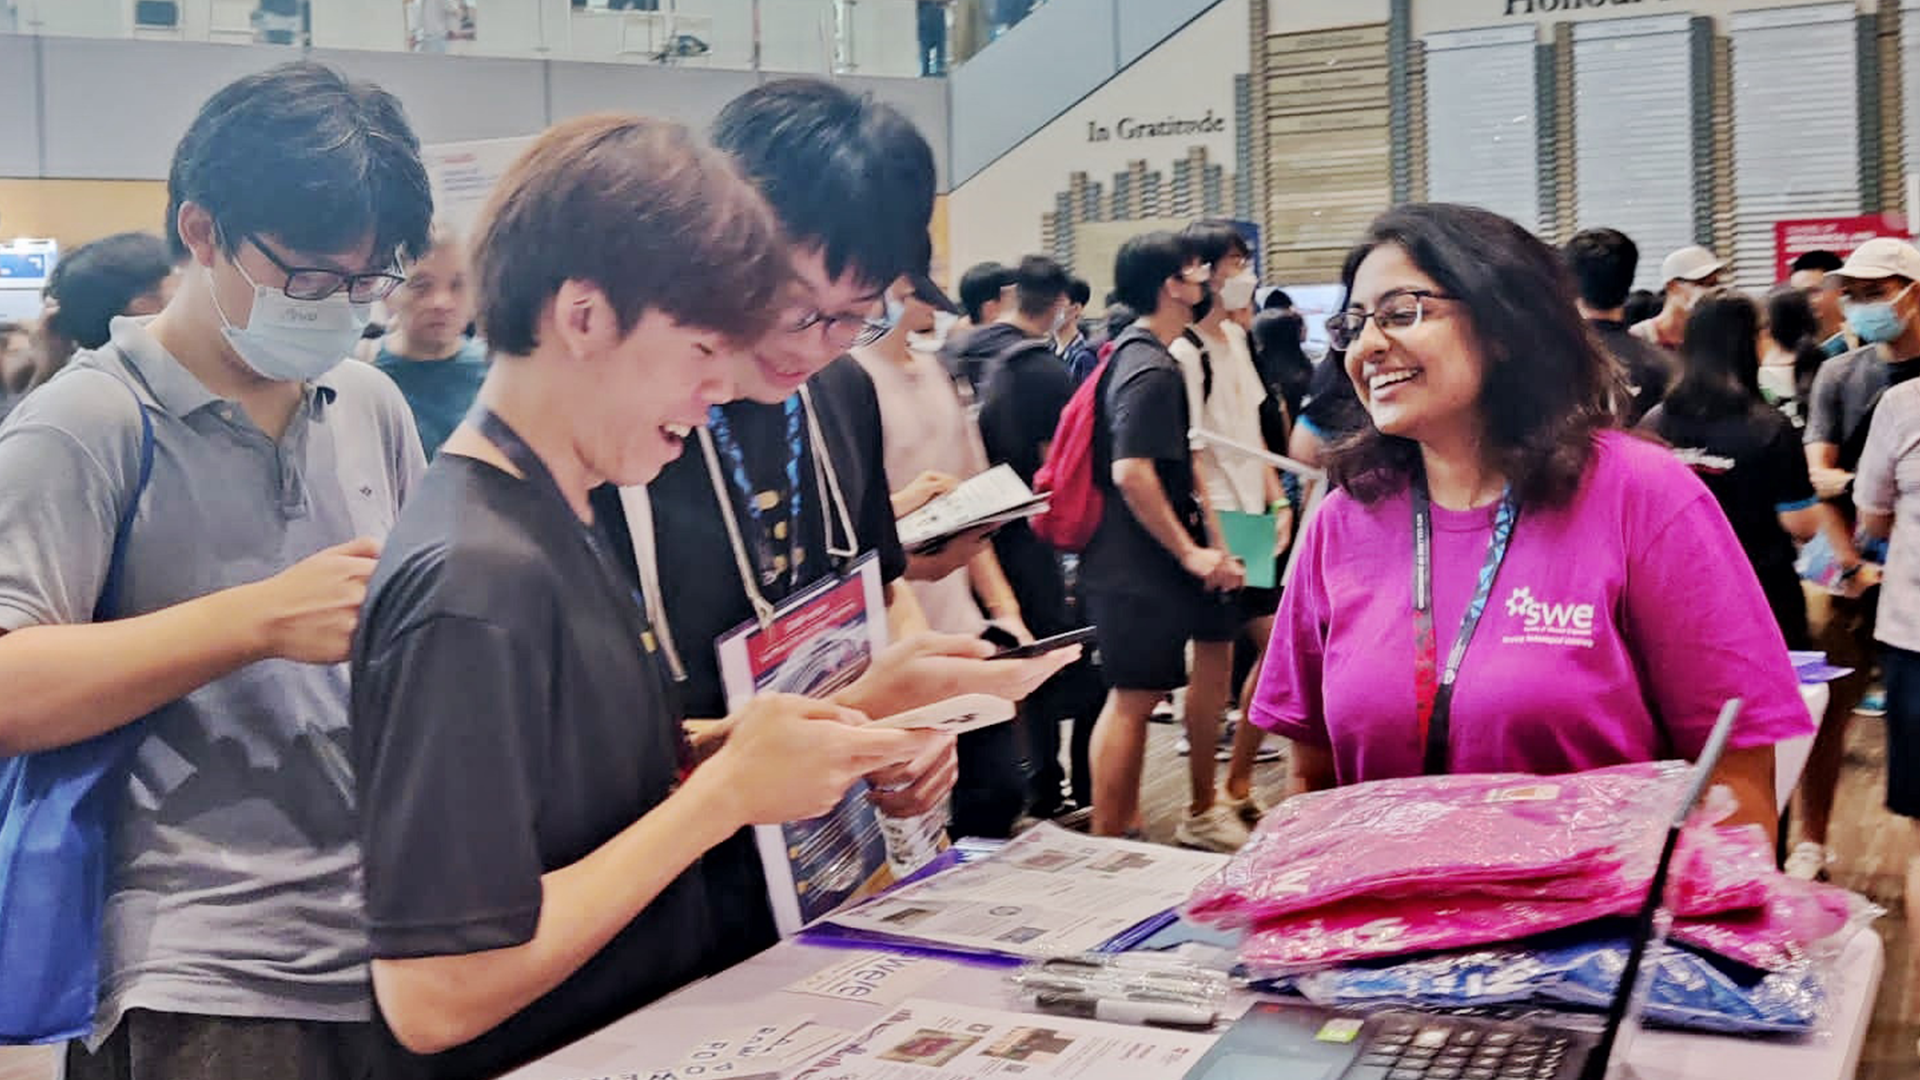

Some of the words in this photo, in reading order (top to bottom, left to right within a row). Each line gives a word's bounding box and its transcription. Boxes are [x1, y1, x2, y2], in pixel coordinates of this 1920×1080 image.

[1502, 0, 1642, 16] Hono
[1087, 121, 1110, 142] In
[1117, 109, 1225, 140] Gratitude
[1523, 602, 1595, 628] swe
